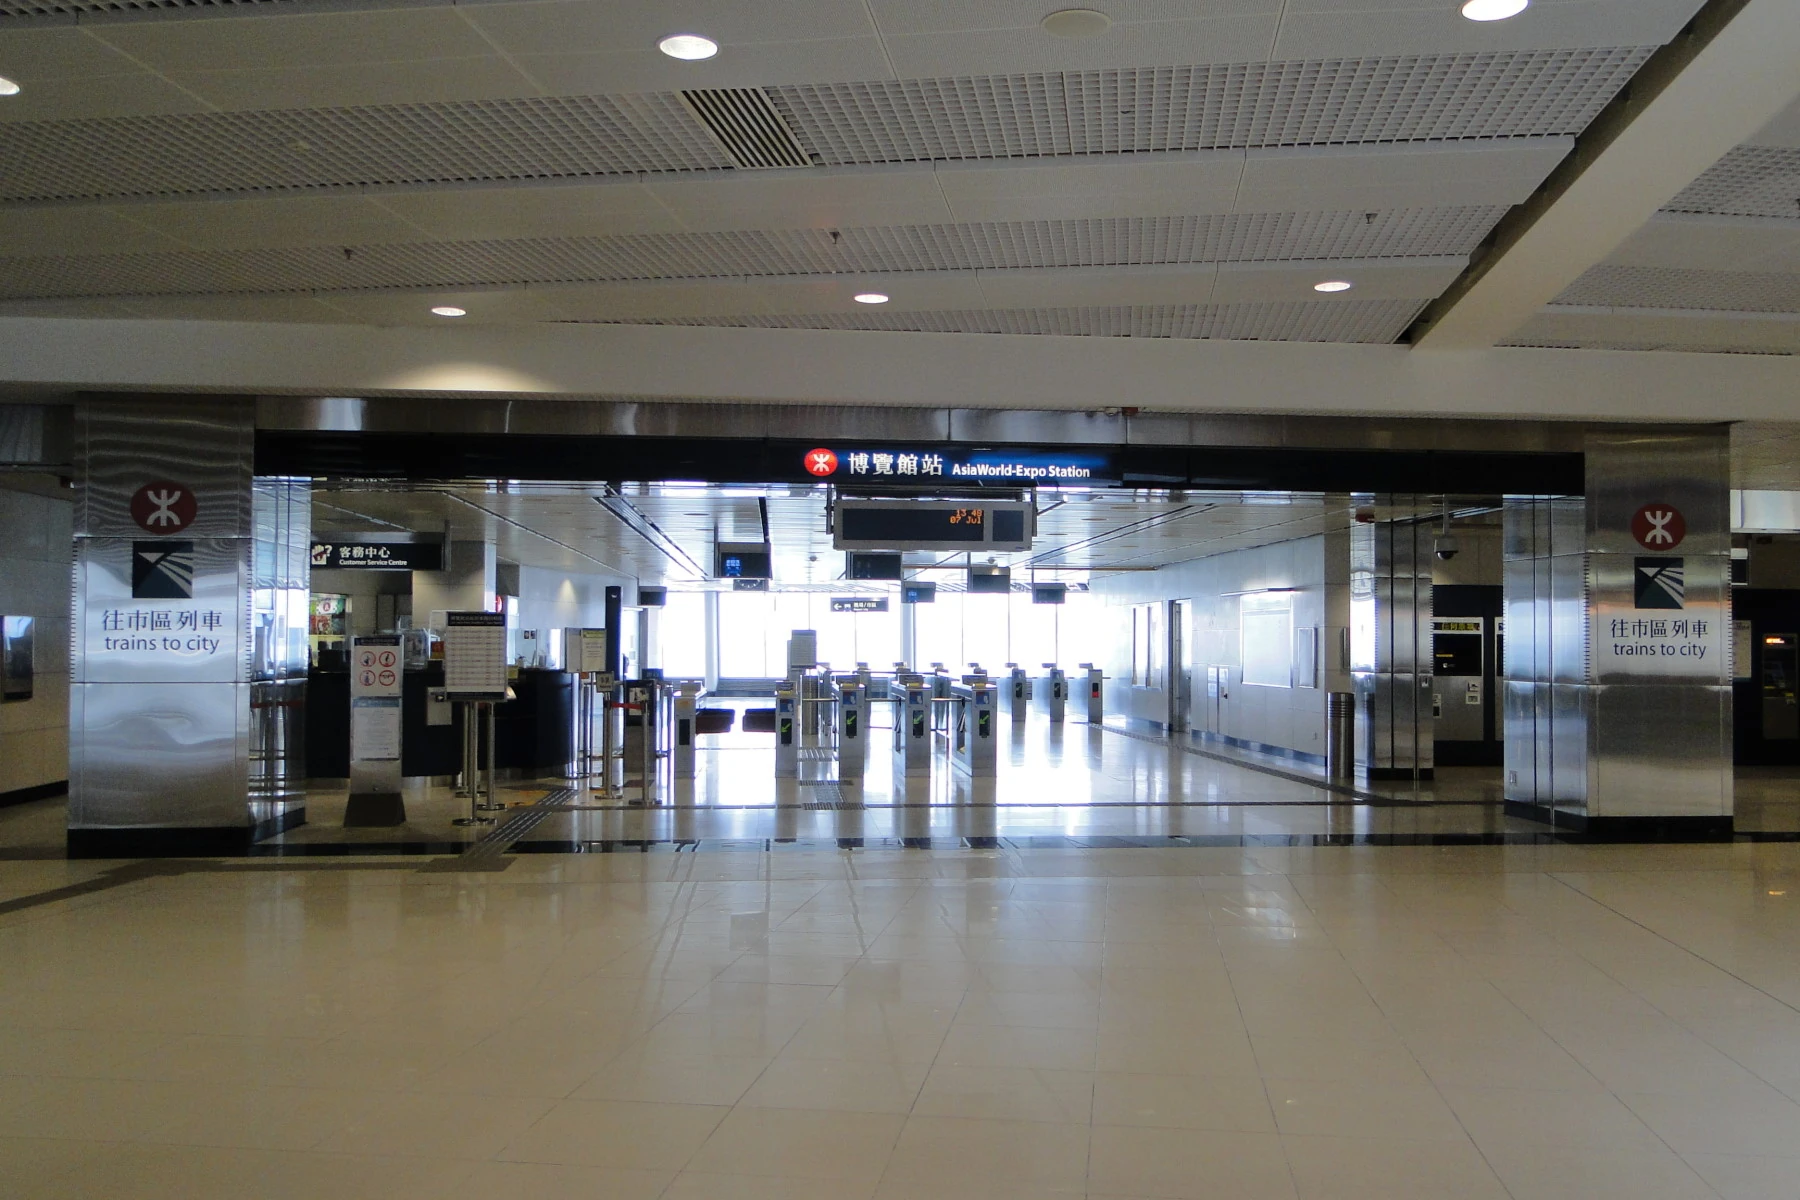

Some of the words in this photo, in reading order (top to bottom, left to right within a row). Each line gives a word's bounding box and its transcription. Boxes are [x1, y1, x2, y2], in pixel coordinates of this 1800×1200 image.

[848, 453, 943, 476] 博覽館站
[952, 463, 1046, 479] AsiaWorld-Expo
[1049, 465, 1090, 478] Station
[339, 546, 391, 559] 客務中心
[102, 609, 223, 632] 往市區列車
[1611, 618, 1709, 639] 往市區列車
[105, 634, 157, 651] trains
[162, 636, 182, 651] to
[186, 634, 220, 655] city
[1613, 641, 1656, 656] trains
[1660, 643, 1676, 656] to
[1679, 641, 1707, 660] city
